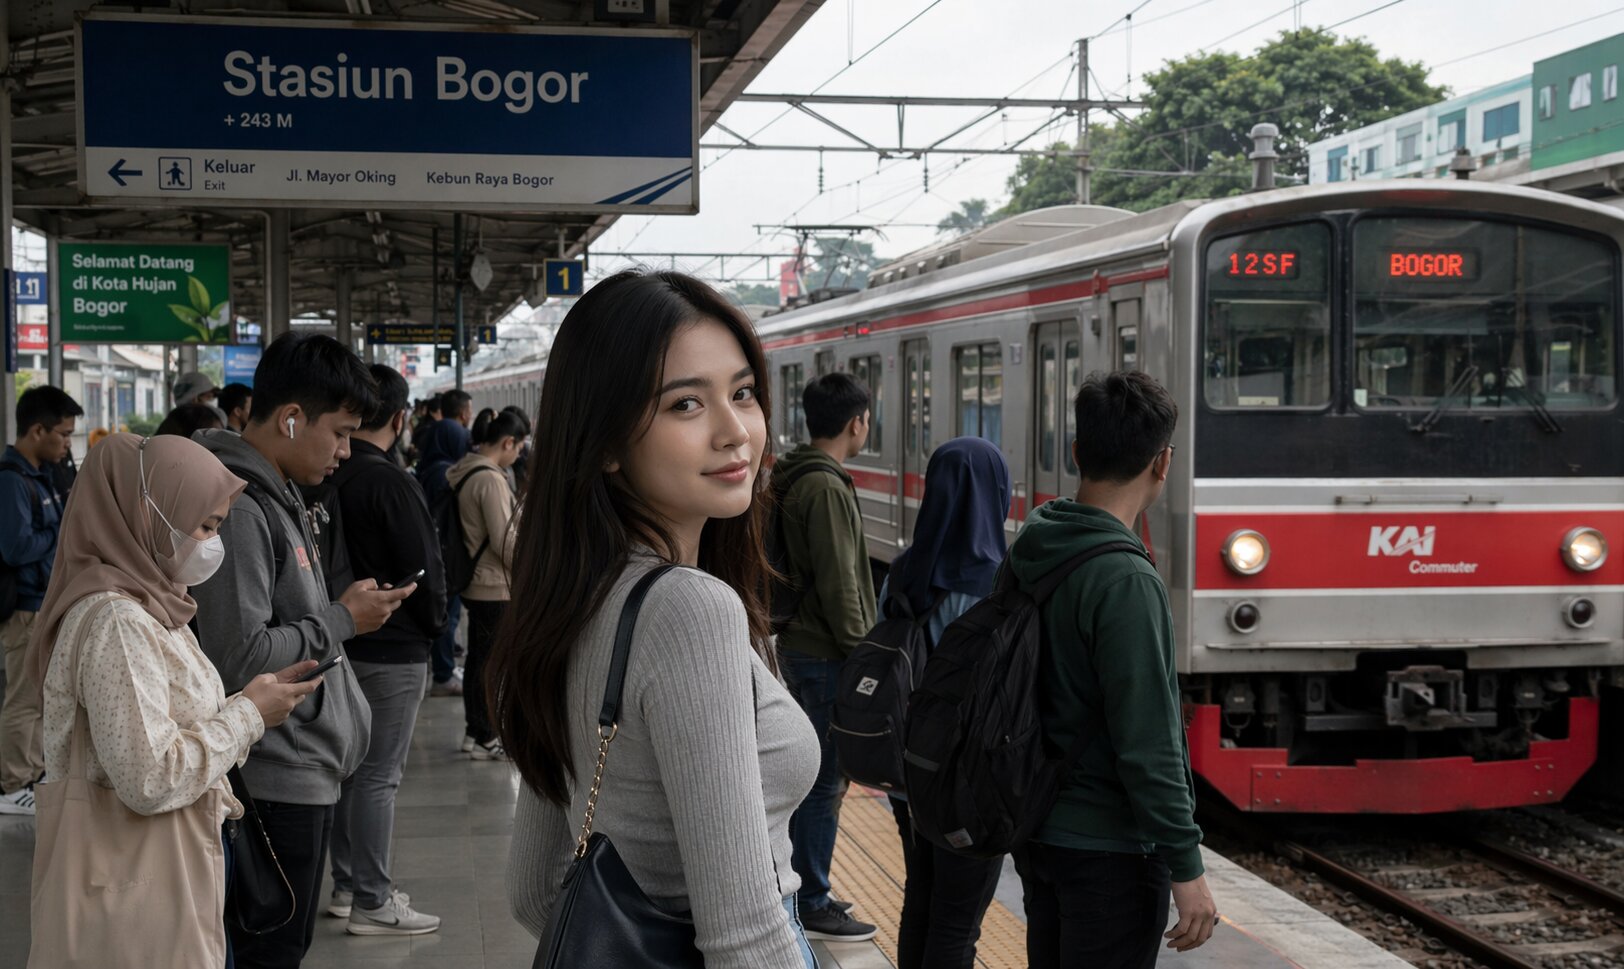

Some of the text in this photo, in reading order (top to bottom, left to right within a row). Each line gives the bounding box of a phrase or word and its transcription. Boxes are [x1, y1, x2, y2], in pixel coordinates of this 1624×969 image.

[223, 50, 590, 114] Stasiun Bogor
[240, 112, 272, 128] 243
[276, 113, 293, 128] M
[203, 158, 256, 175] Keluar
[203, 179, 226, 191] Exit
[286, 169, 397, 187] Jl. Mayor Oking
[426, 171, 555, 190] Kebun Raya Bogor
[71, 253, 195, 273] Selamat Datang
[1229, 252, 1296, 276] 12SF
[1390, 253, 1464, 277] BOGOR
[72, 275, 178, 295] di Kota Hujan
[558, 267, 569, 290] 1
[73, 297, 128, 319] Bogor
[483, 329, 491, 342] 1
[1368, 526, 1436, 556] KAI
[1408, 560, 1478, 574] Commuter
